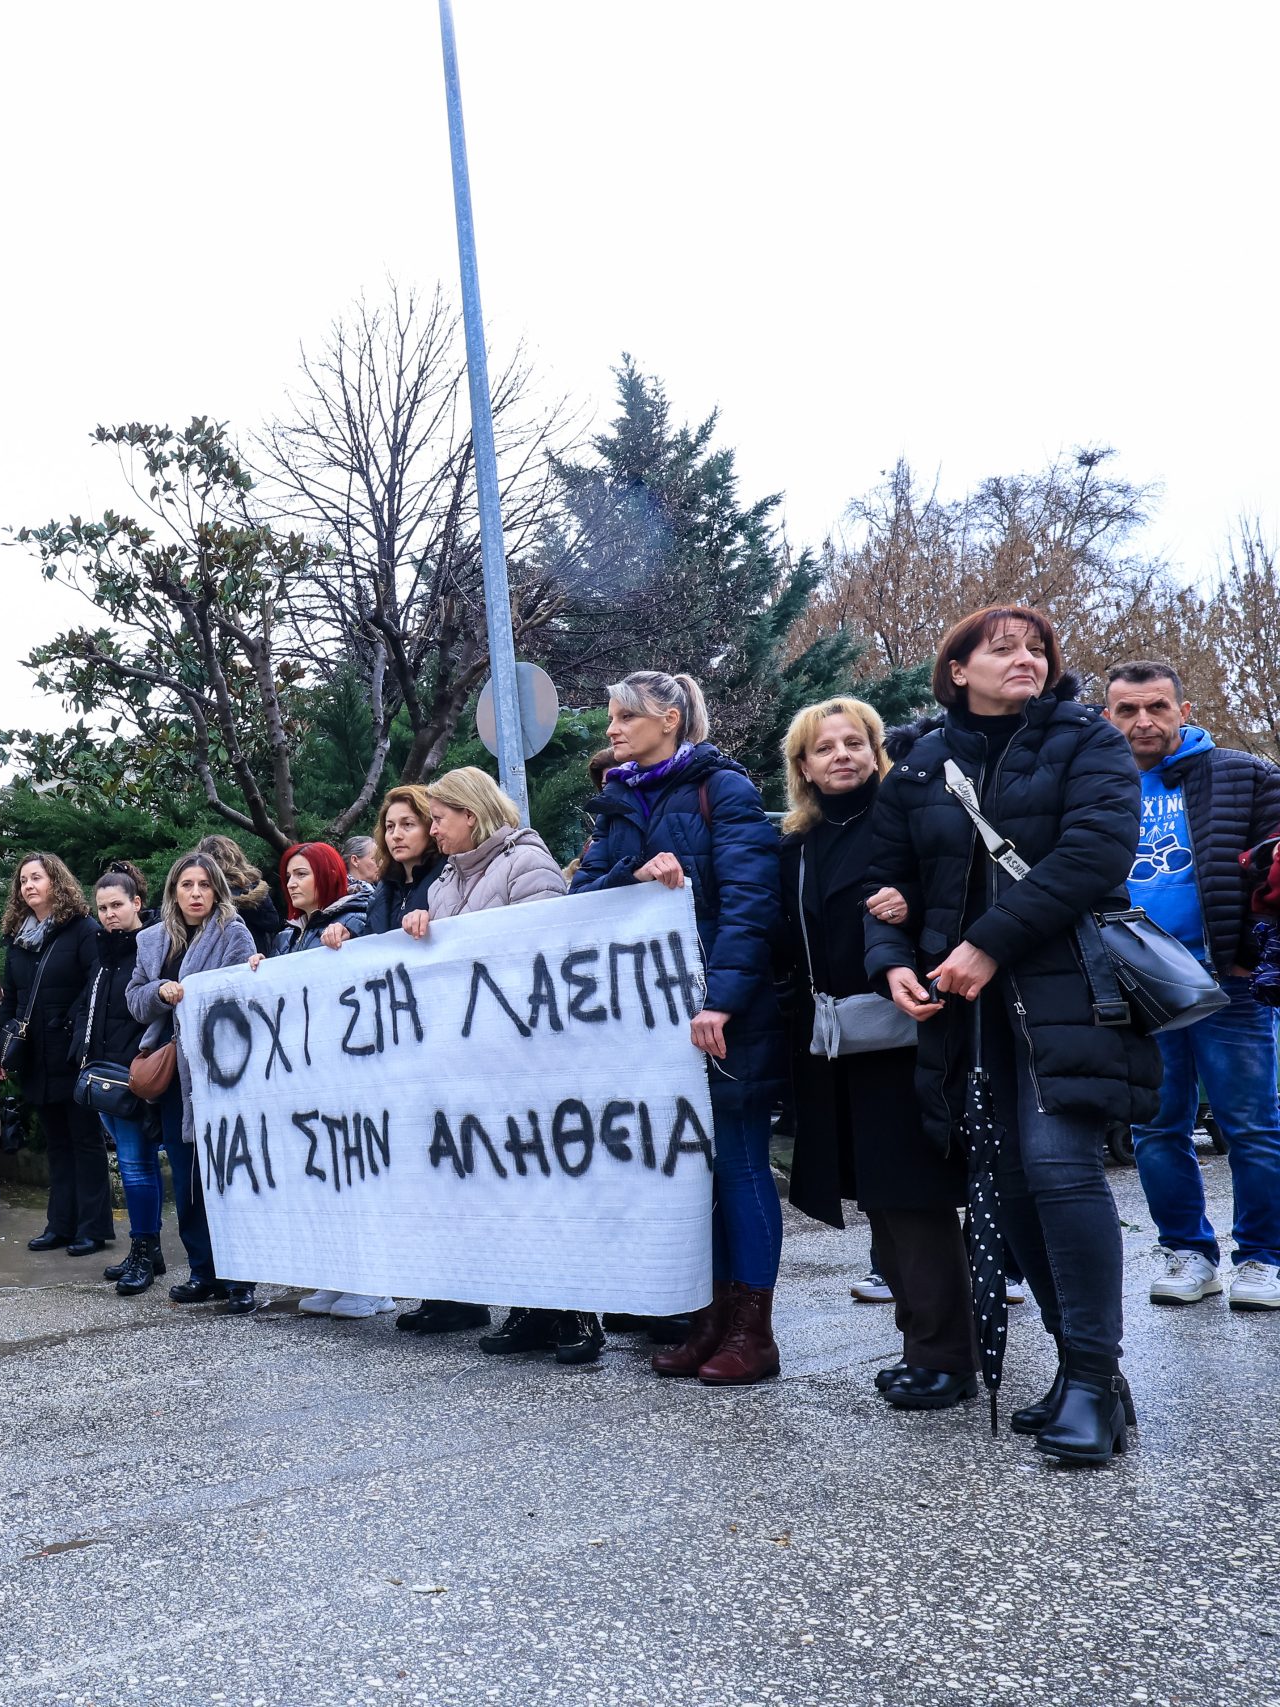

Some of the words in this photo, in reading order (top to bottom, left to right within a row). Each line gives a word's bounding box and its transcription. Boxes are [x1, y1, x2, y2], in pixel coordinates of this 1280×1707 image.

[1163, 821, 1175, 832] 74
[202, 985, 311, 1088] ΟΧΙ
[339, 961, 424, 1056] ΣΤΗ
[461, 931, 701, 1037] ΛΑΣΠΗ
[204, 1110, 276, 1195] ΝΑΙ
[291, 1109, 391, 1193] ΣΤΗΝ
[428, 1095, 714, 1179] ΑΛΗΘΕΙΑ
